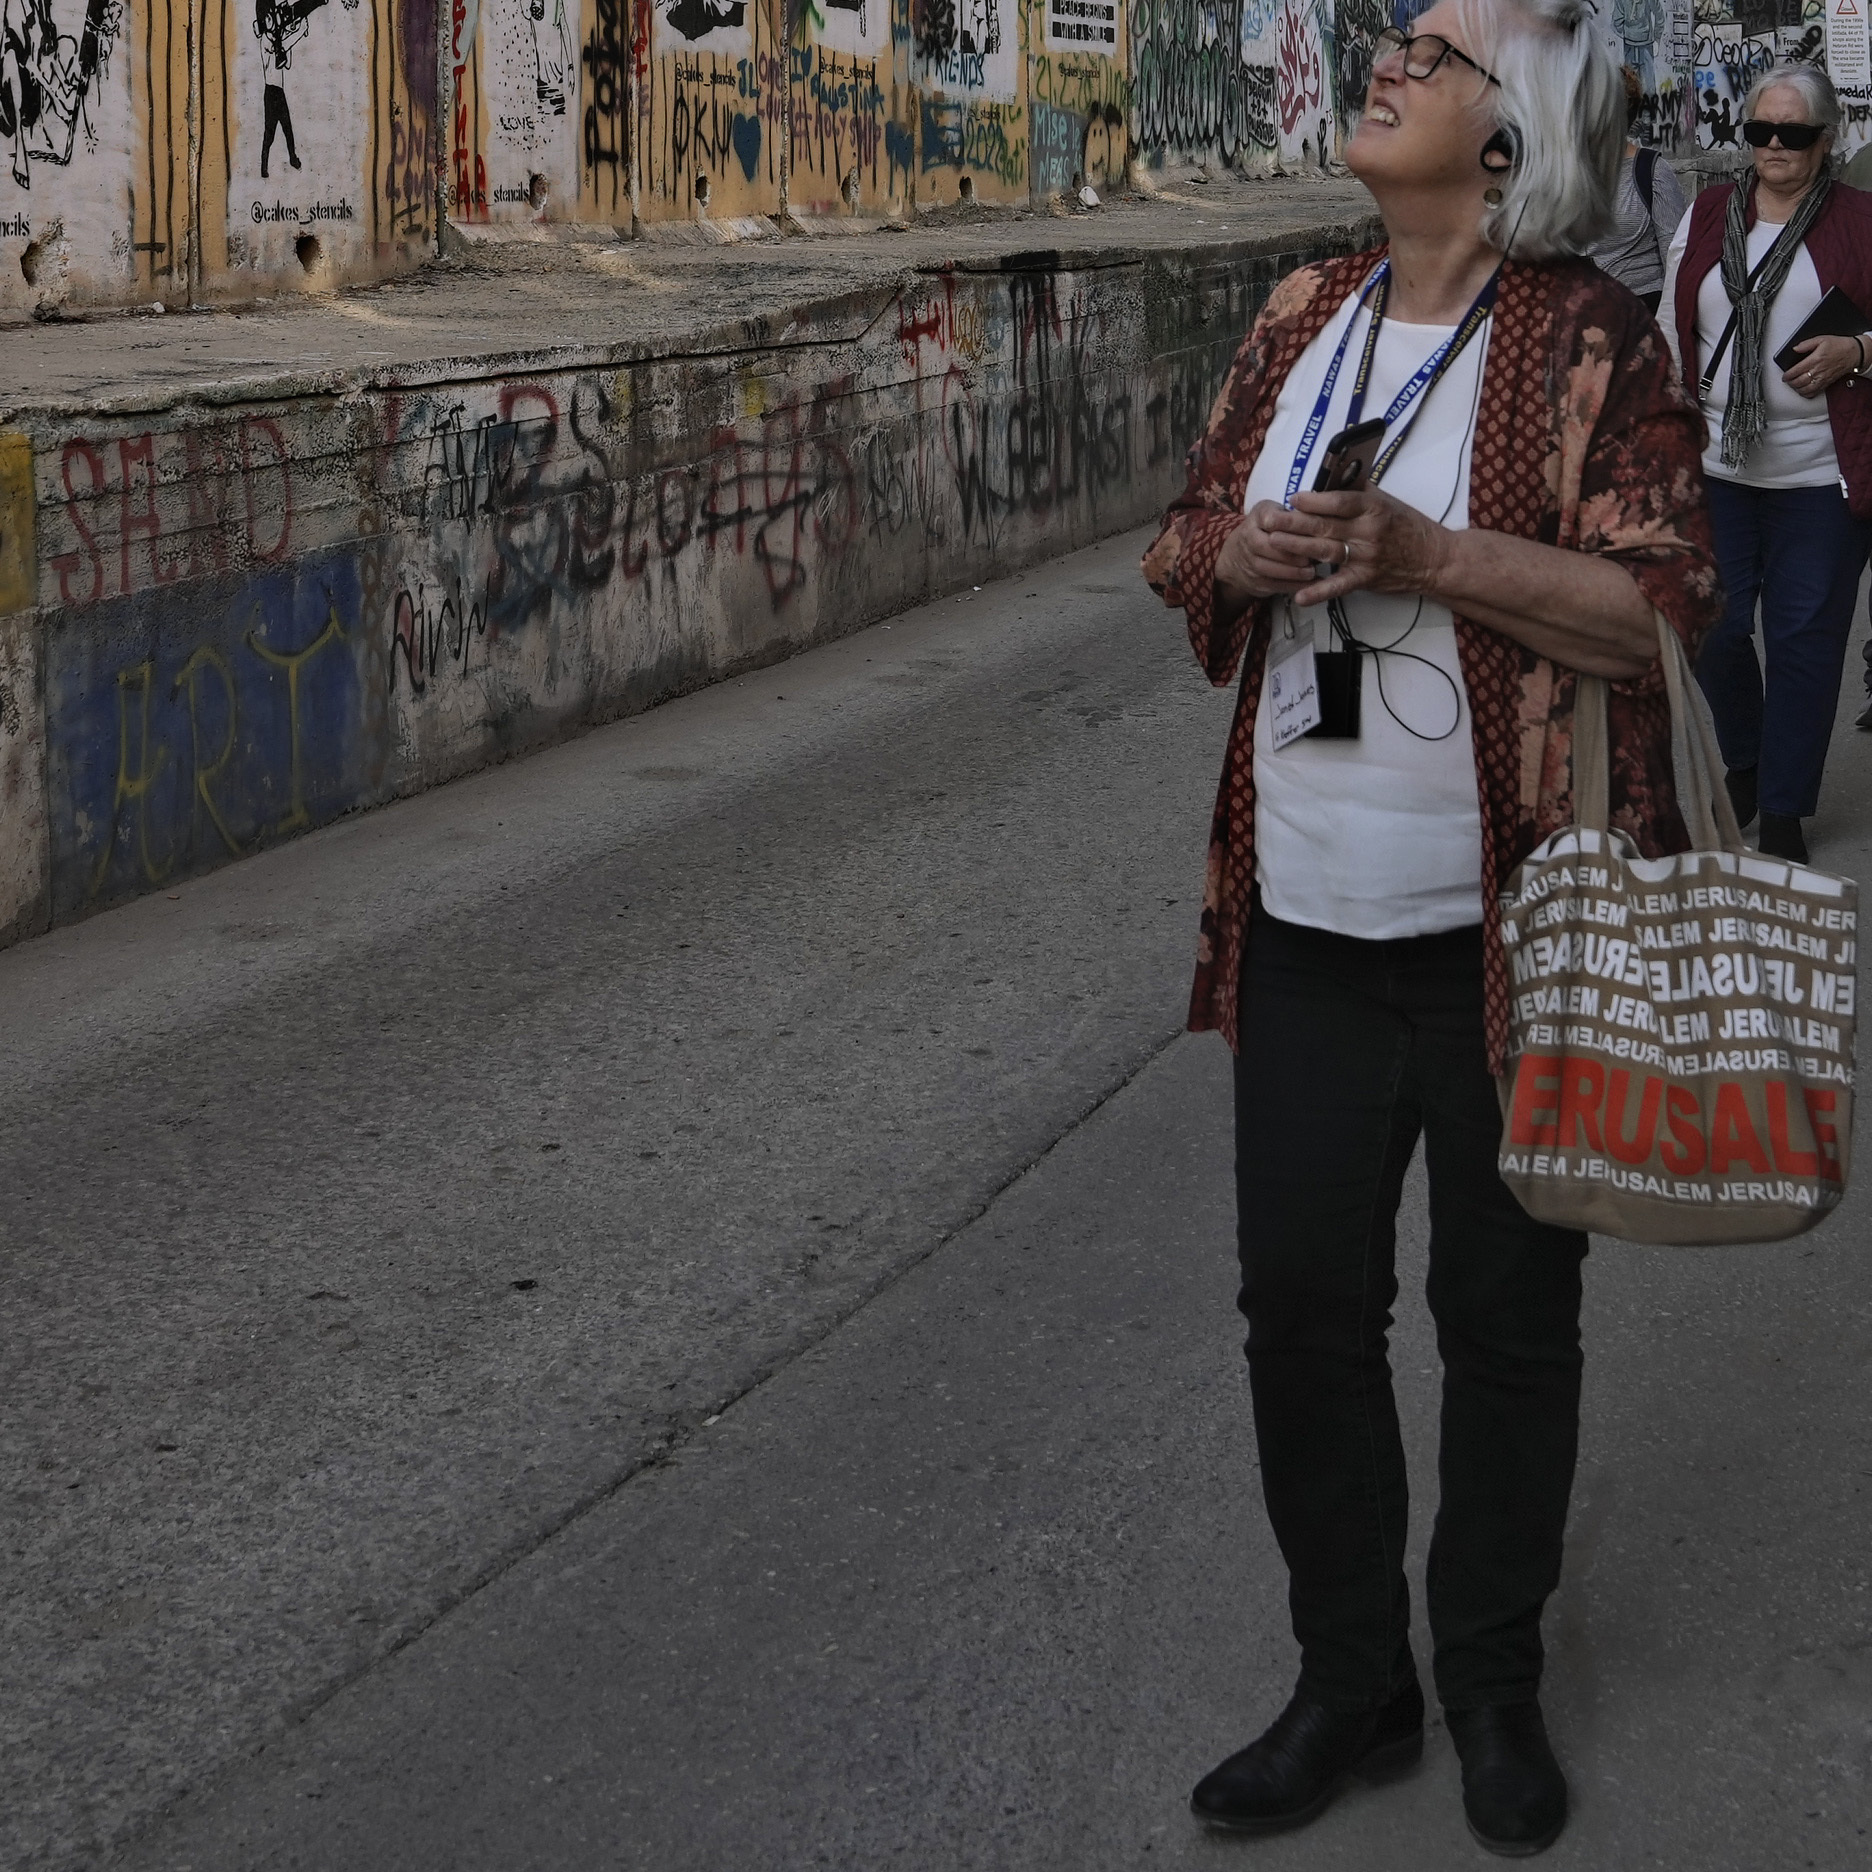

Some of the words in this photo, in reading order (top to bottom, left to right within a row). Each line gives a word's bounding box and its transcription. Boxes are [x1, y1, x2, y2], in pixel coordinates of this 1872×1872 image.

[251, 200, 353, 225] @cakes_stencils
[1296, 415, 1322, 460] TRAVEL
[1681, 886, 1807, 923] JERUSALEM
